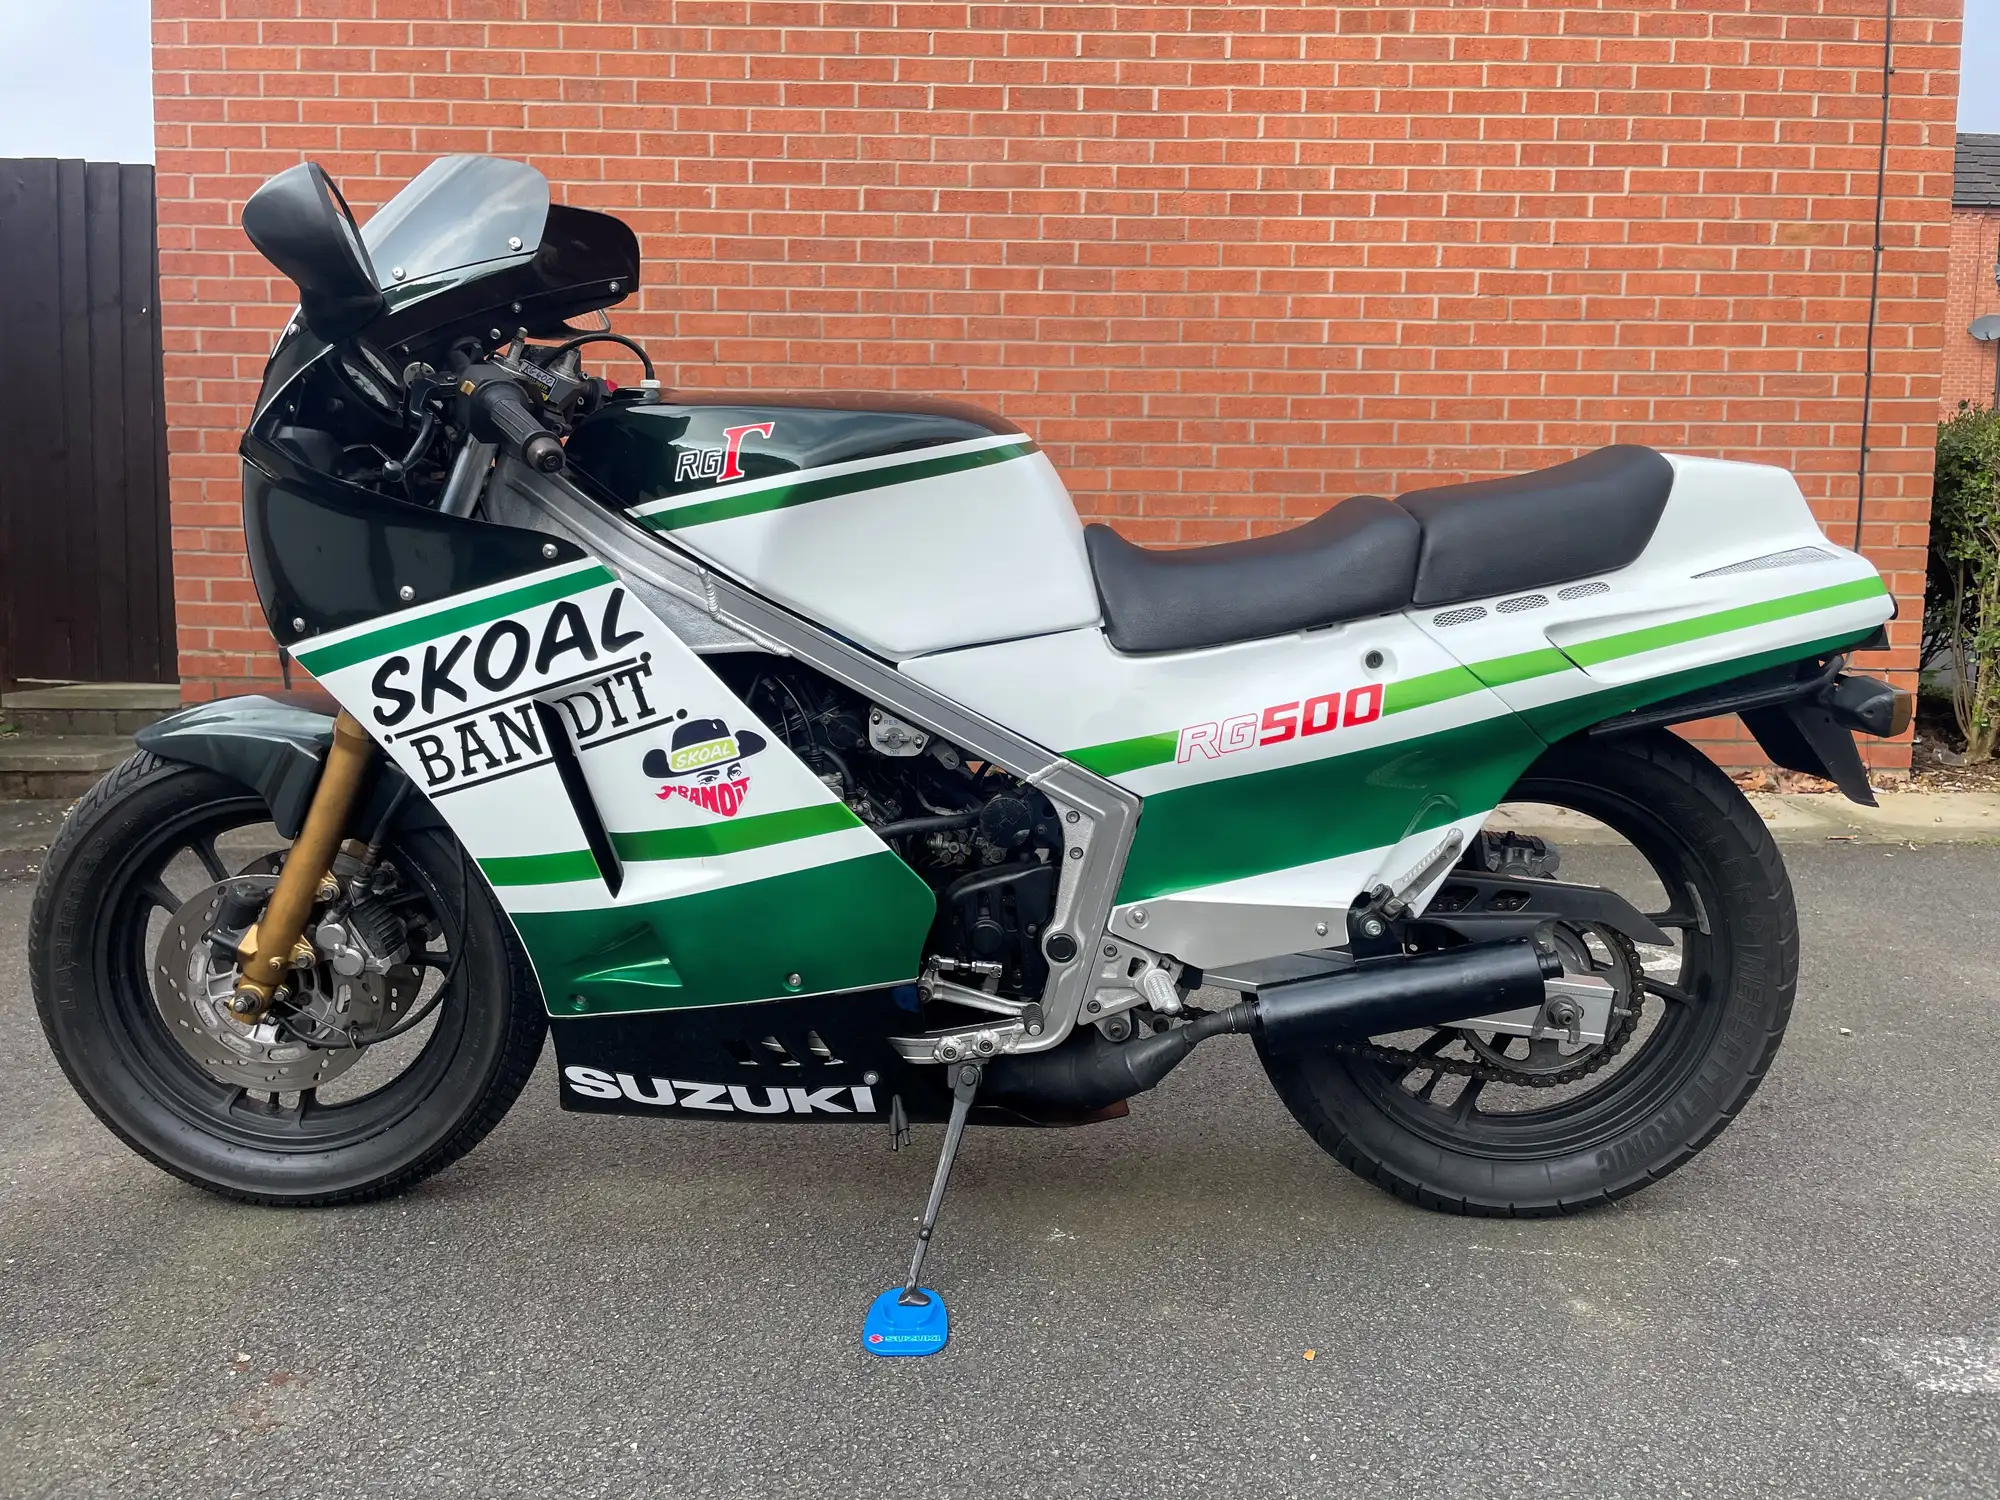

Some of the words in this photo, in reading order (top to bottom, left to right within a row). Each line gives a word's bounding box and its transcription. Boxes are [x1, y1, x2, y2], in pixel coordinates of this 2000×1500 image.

[372, 587, 644, 727] SKOAL
[676, 741, 731, 768] SKOAL
[1177, 683, 1384, 764] RG500
[564, 1065, 877, 1114] SUZUKI
